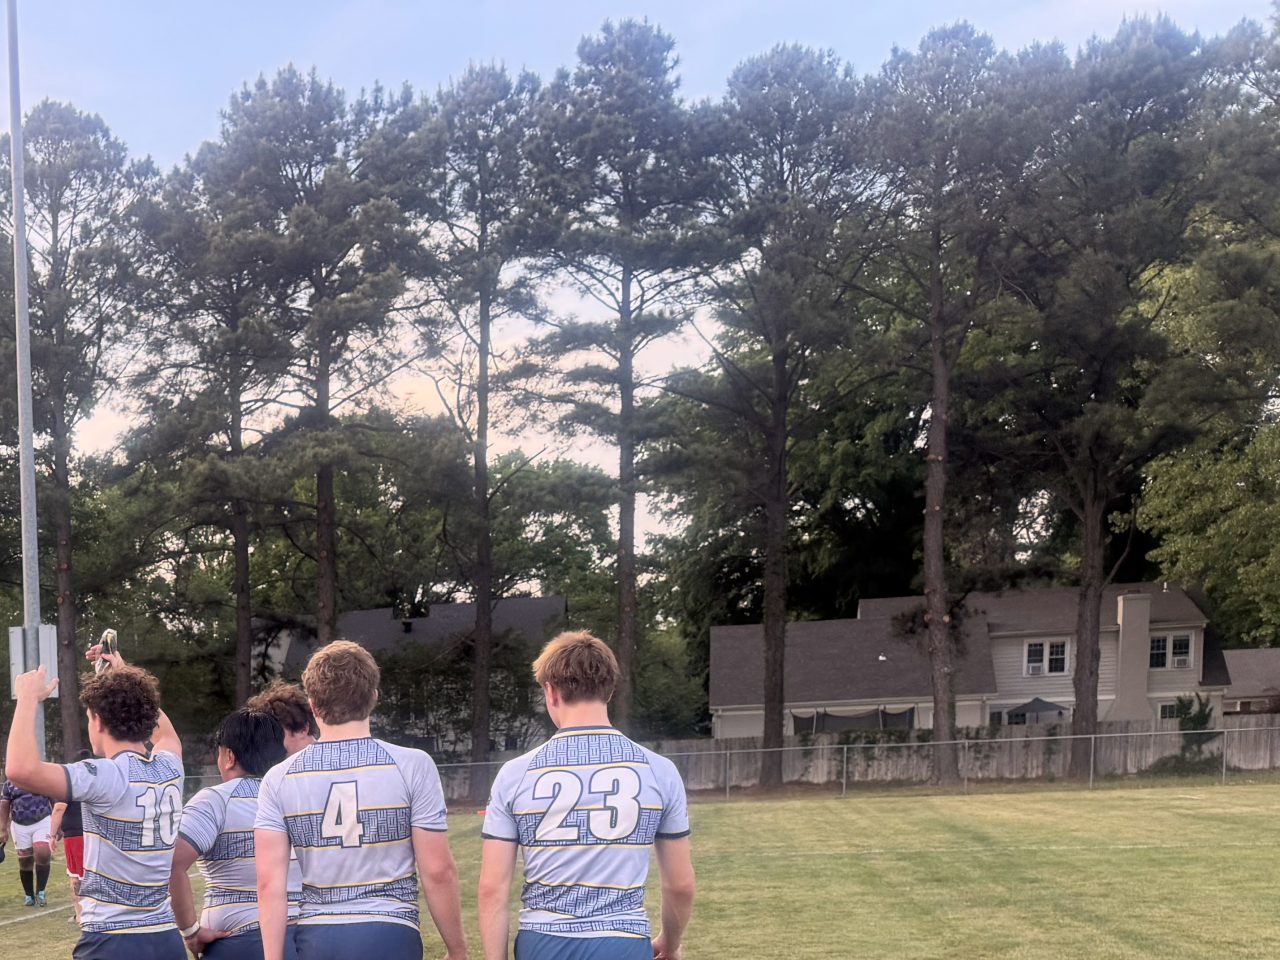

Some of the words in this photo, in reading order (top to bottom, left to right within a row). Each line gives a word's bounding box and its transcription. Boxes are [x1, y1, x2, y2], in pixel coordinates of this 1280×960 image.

[136, 784, 182, 847] 10
[320, 780, 364, 848] 4
[532, 766, 641, 842] 23
